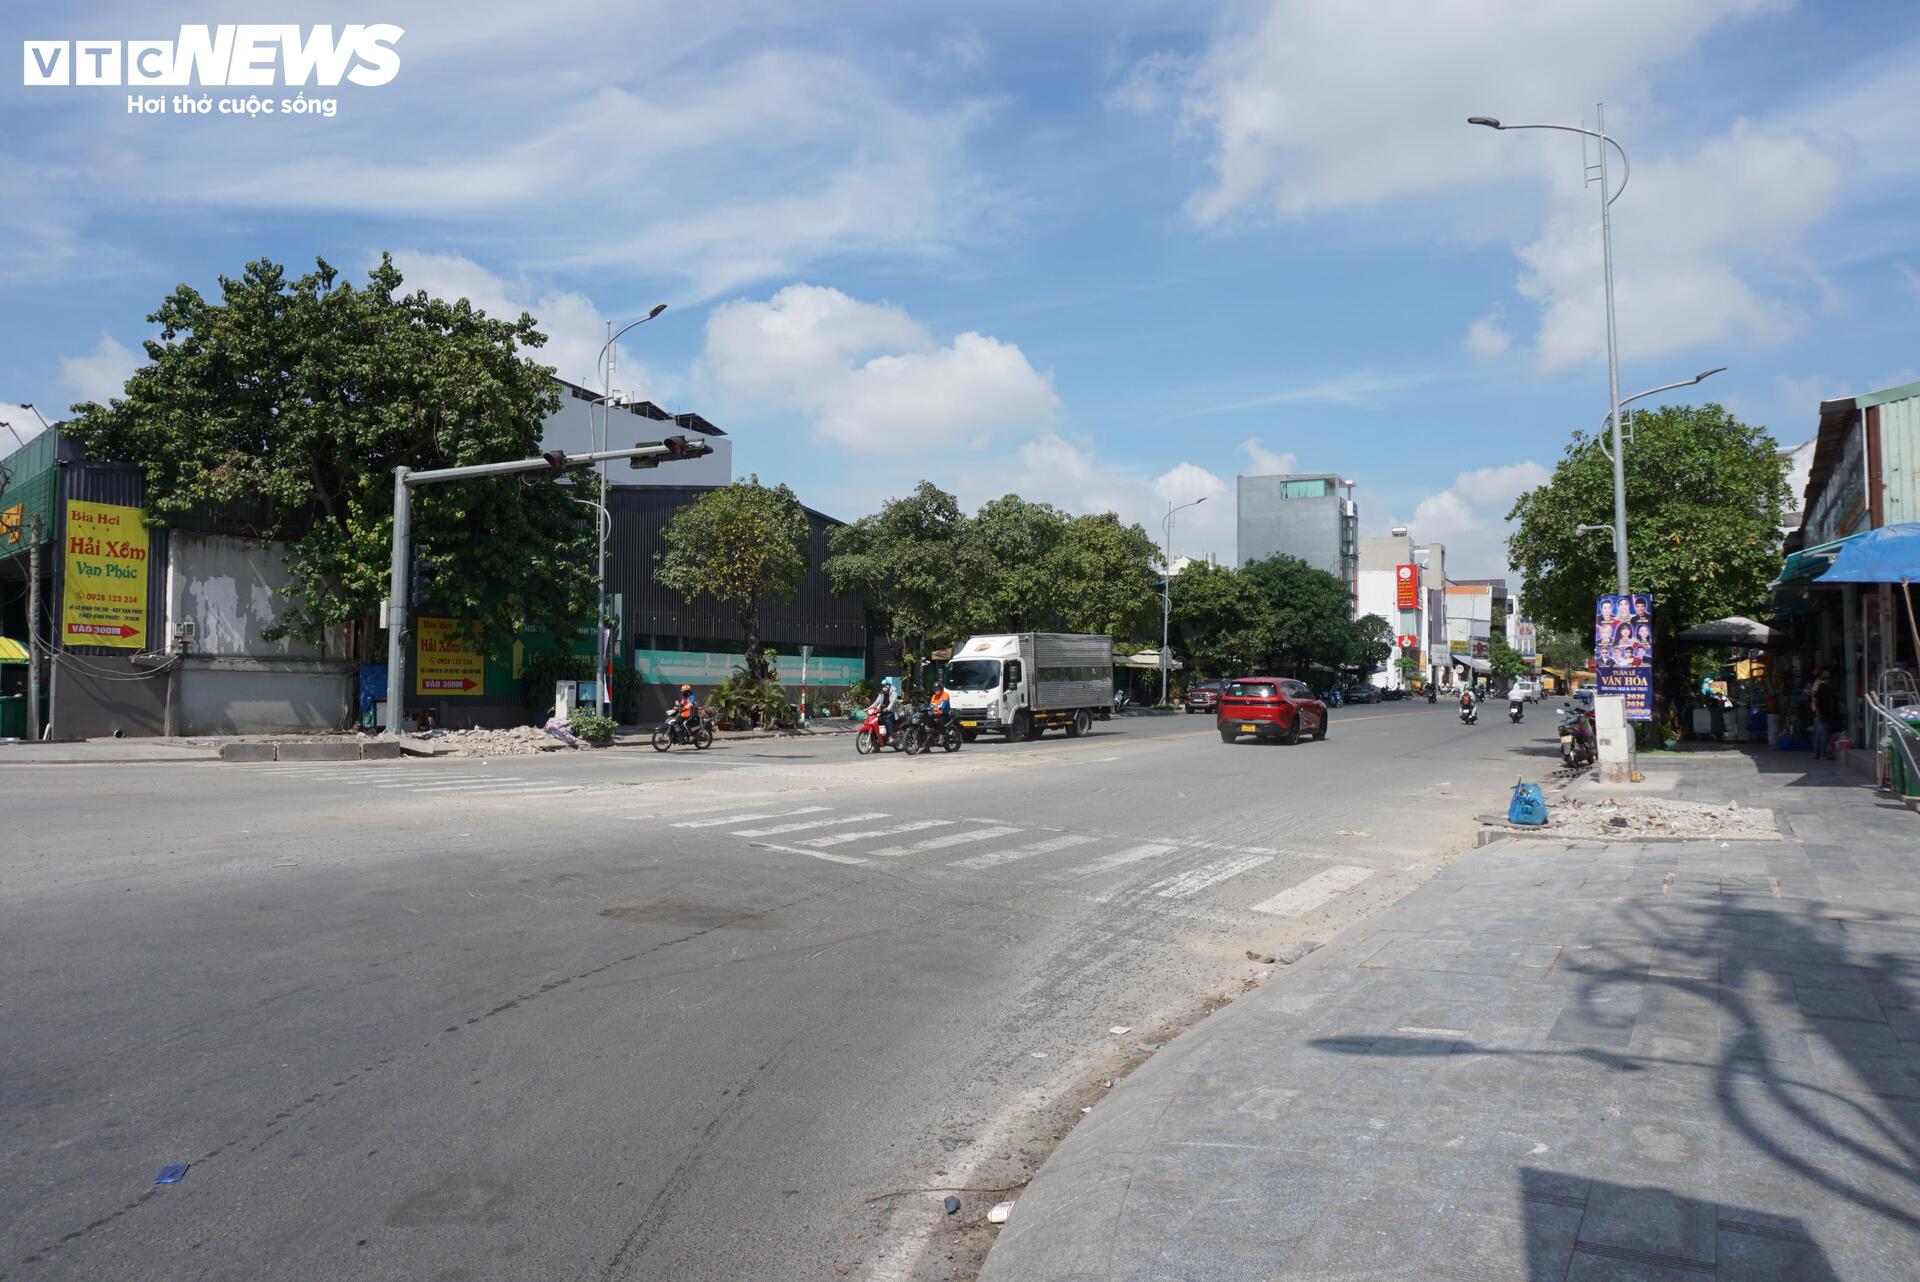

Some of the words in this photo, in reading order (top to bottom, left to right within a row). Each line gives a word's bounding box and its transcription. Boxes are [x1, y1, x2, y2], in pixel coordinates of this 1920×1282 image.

[71, 510, 93, 522] Bia
[97, 513, 120, 526] Hơi
[70, 536, 100, 556] Hải
[77, 560, 102, 578] Vạn
[105, 564, 137, 579] Phúc
[1601, 675, 1622, 686] VĂN
[1624, 674, 1648, 686] HÓA
